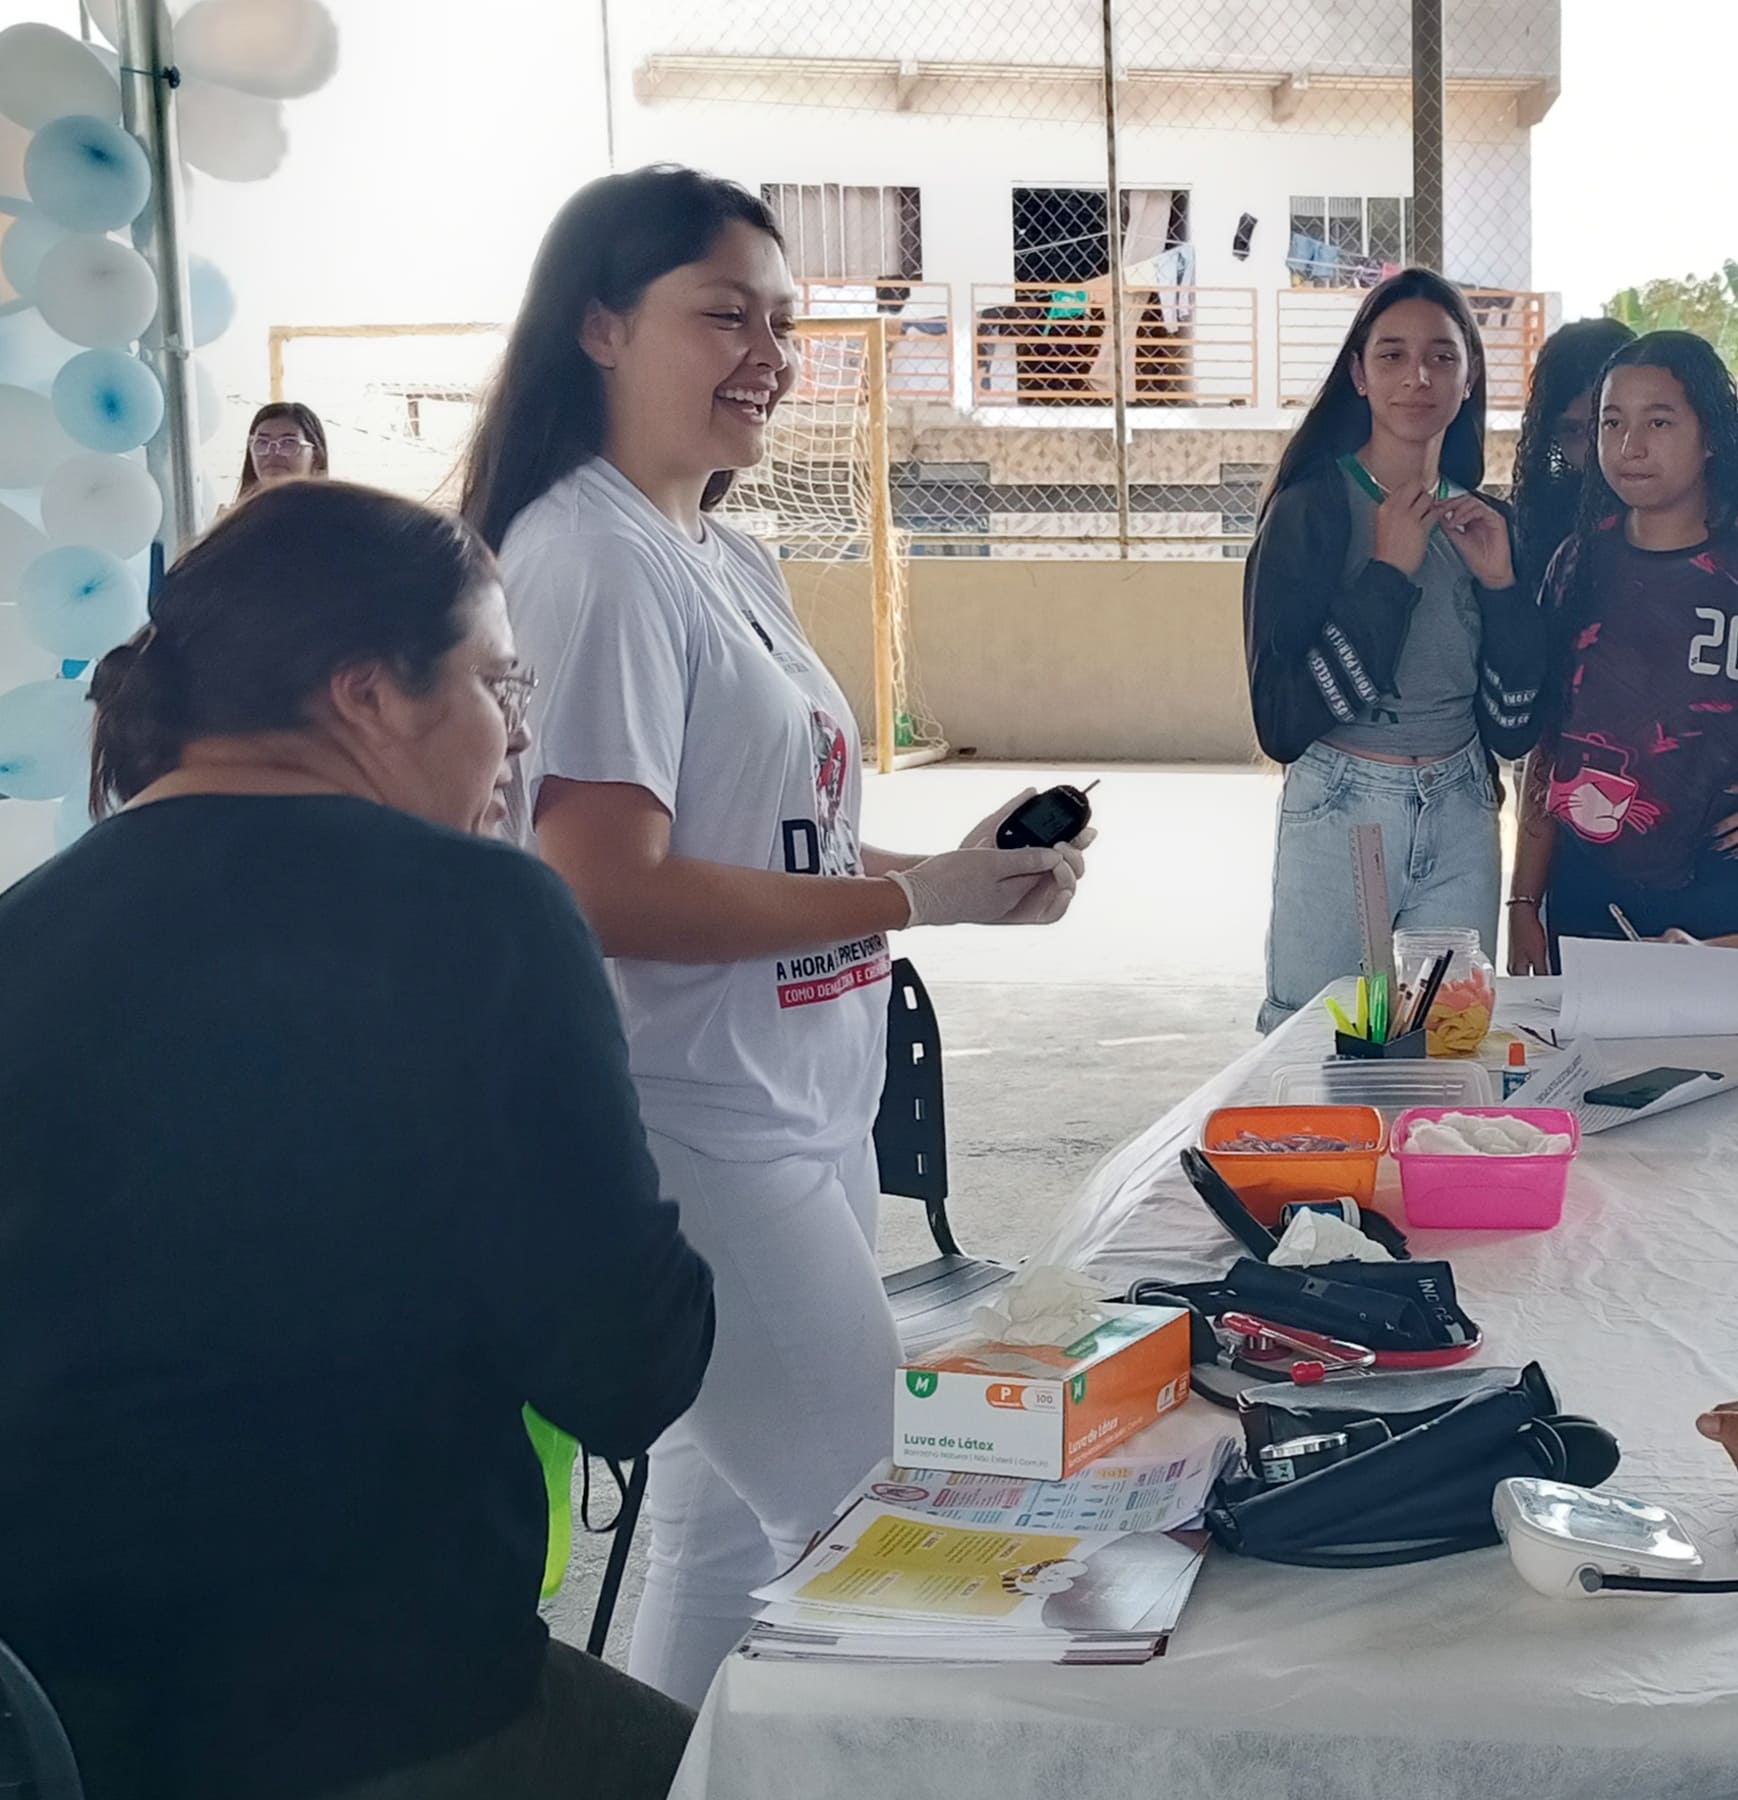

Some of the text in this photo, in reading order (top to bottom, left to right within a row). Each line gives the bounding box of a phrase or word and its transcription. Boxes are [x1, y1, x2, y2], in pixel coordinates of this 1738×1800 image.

[777, 961, 787, 980] A
[790, 953, 835, 979] HORA
[785, 983, 815, 1003] COMO
[915, 1376, 929, 1392] M
[1000, 1386, 1012, 1401] P
[1036, 1394, 1054, 1405] 100
[904, 1433, 995, 1451] Luva de Látex
